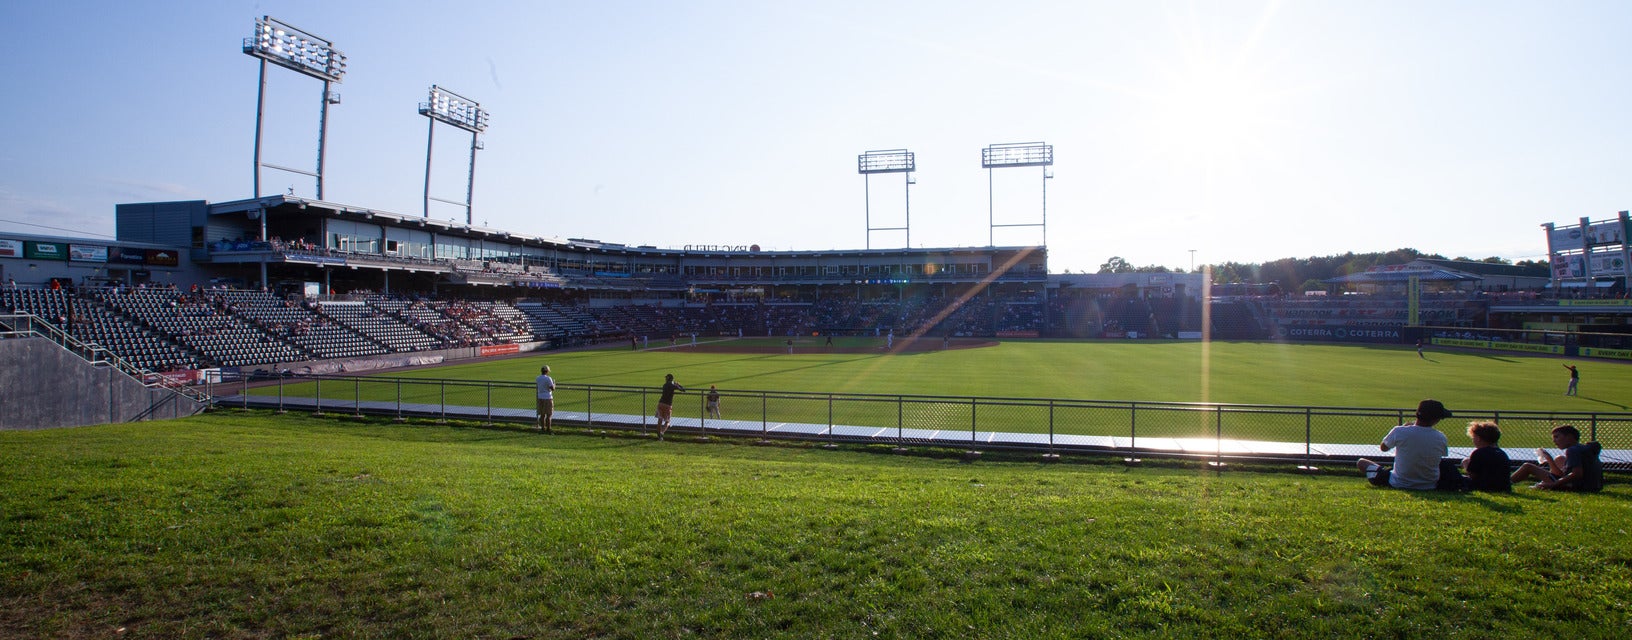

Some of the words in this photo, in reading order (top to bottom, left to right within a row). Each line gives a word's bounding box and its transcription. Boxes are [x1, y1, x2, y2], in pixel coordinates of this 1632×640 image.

[1394, 310, 1456, 320] HAKOOK
[1290, 328, 1332, 336] COTERRA
[1349, 329, 1399, 338] COTERRA
